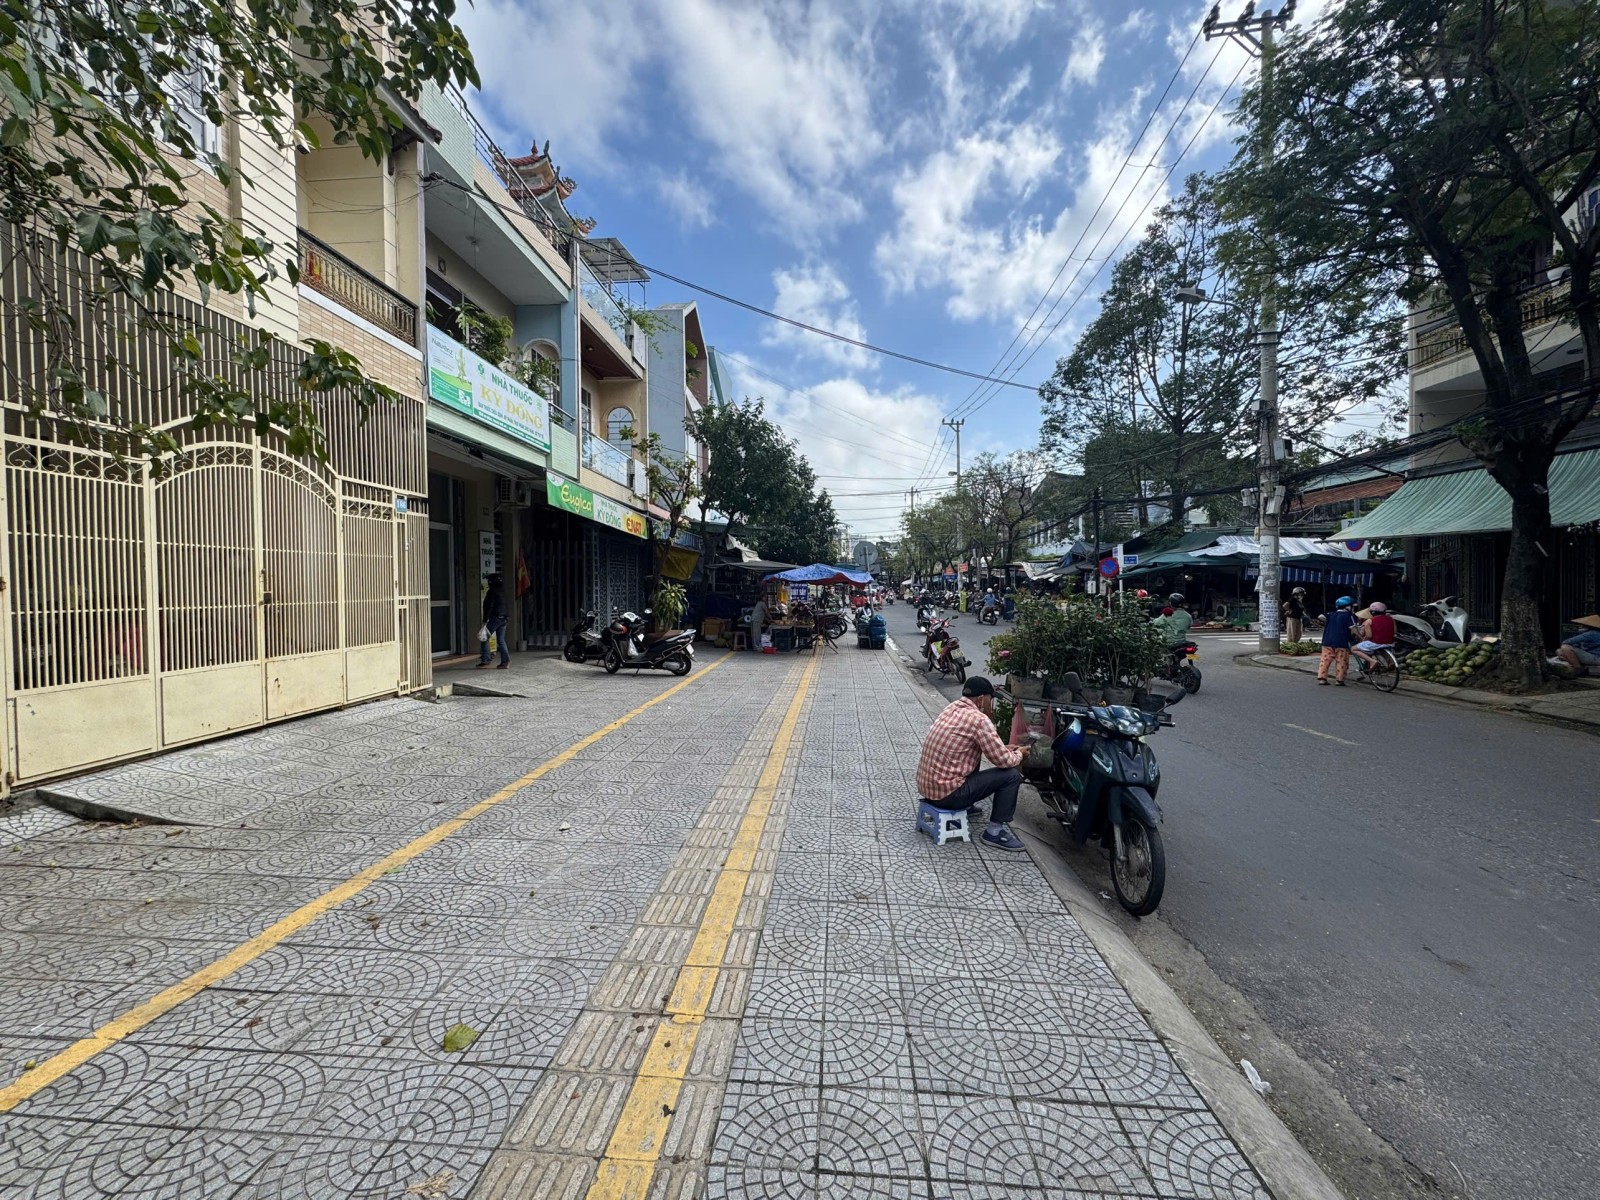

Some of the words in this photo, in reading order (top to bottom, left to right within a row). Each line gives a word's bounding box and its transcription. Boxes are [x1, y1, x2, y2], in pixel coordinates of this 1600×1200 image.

[492, 373, 508, 391] NHÀ
[508, 383, 533, 406] THUỐC
[562, 485, 592, 513] Eugica
